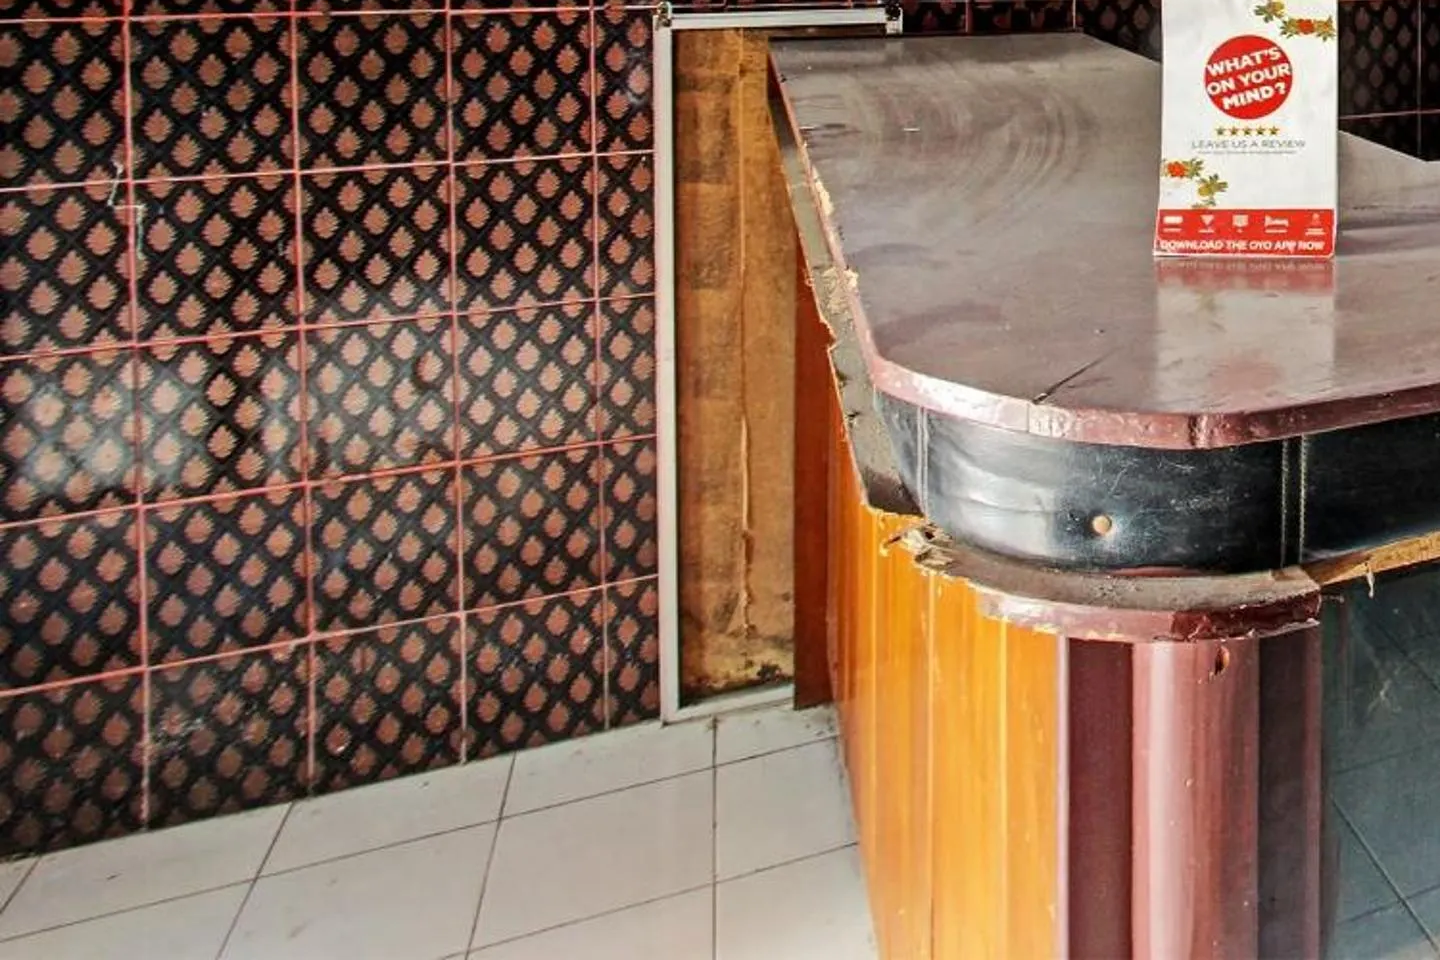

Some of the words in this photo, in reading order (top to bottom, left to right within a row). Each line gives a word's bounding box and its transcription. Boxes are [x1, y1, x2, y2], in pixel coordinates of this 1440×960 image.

[1206, 46, 1282, 77] WHAT'S
[1207, 77, 1236, 96] ON
[1236, 62, 1291, 87] YOUR
[1191, 139, 1228, 149] LEAVE
[1231, 139, 1247, 149] US
[1250, 139, 1259, 148] A
[1261, 139, 1306, 149] REVIEW
[1160, 239, 1224, 251] DOWNLOAD
[1226, 240, 1247, 251] THE
[1249, 240, 1273, 251] OYO
[1274, 240, 1297, 251] APP
[1298, 240, 1325, 251] NOW
